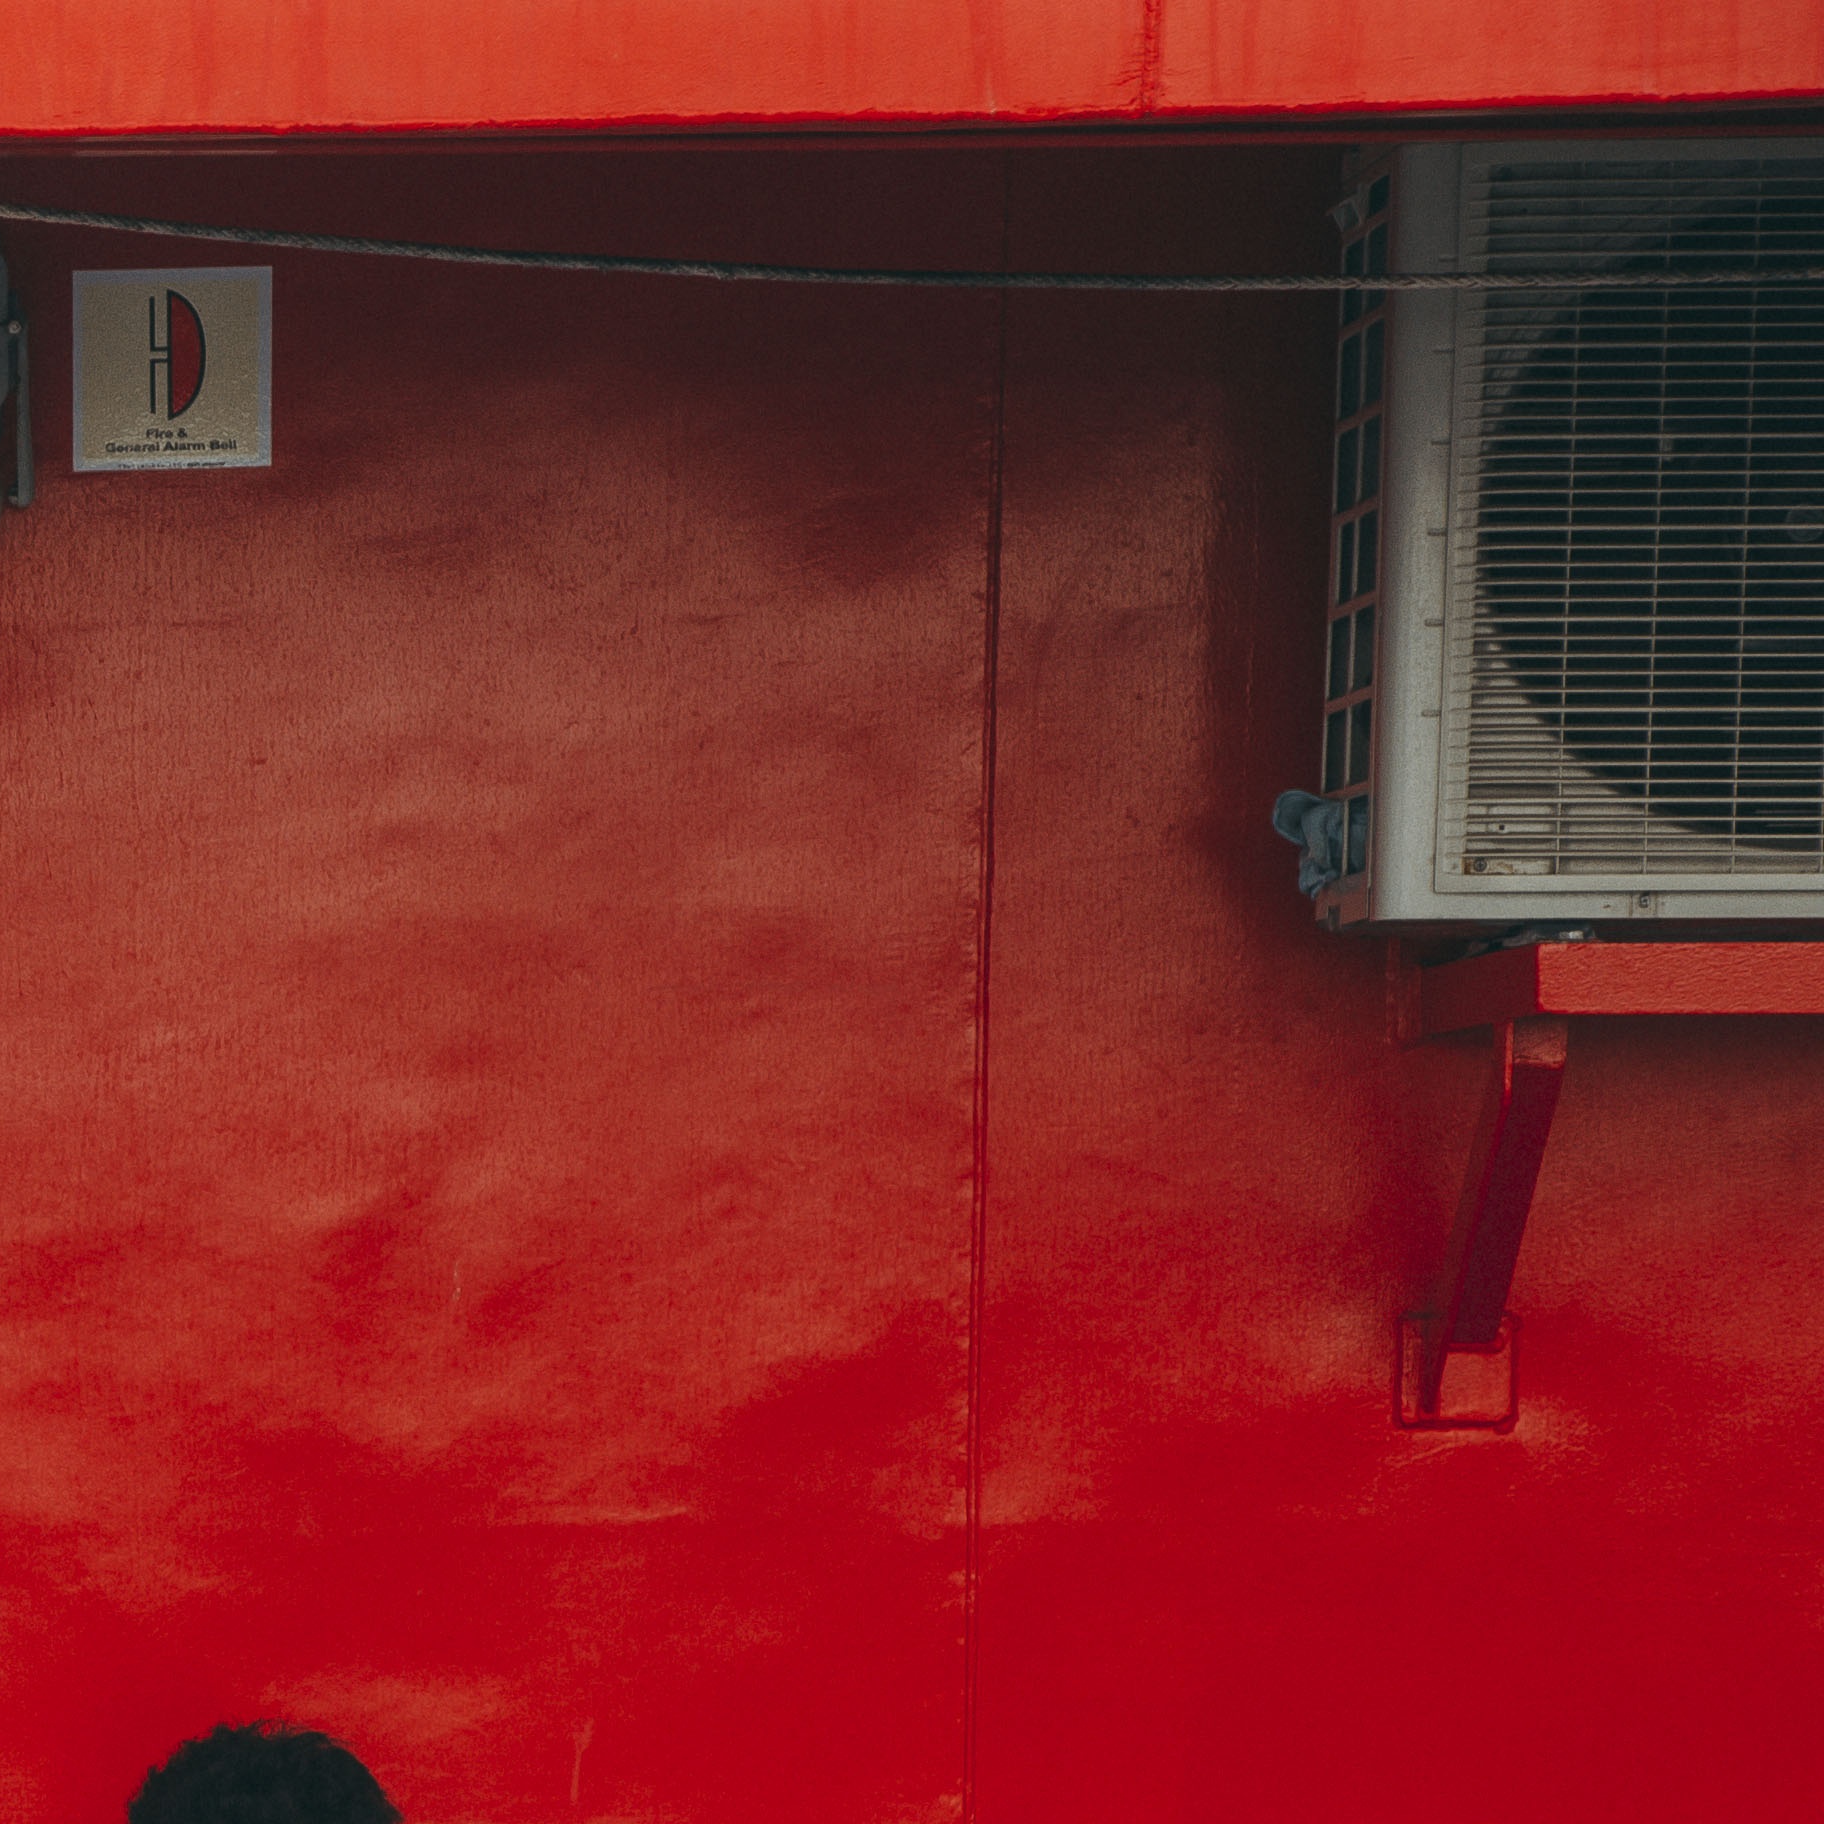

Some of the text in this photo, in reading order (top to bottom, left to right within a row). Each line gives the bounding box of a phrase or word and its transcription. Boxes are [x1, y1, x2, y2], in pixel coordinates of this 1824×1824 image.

[146, 427, 188, 439] Fire &
[105, 439, 237, 453] General Alarm Bell
